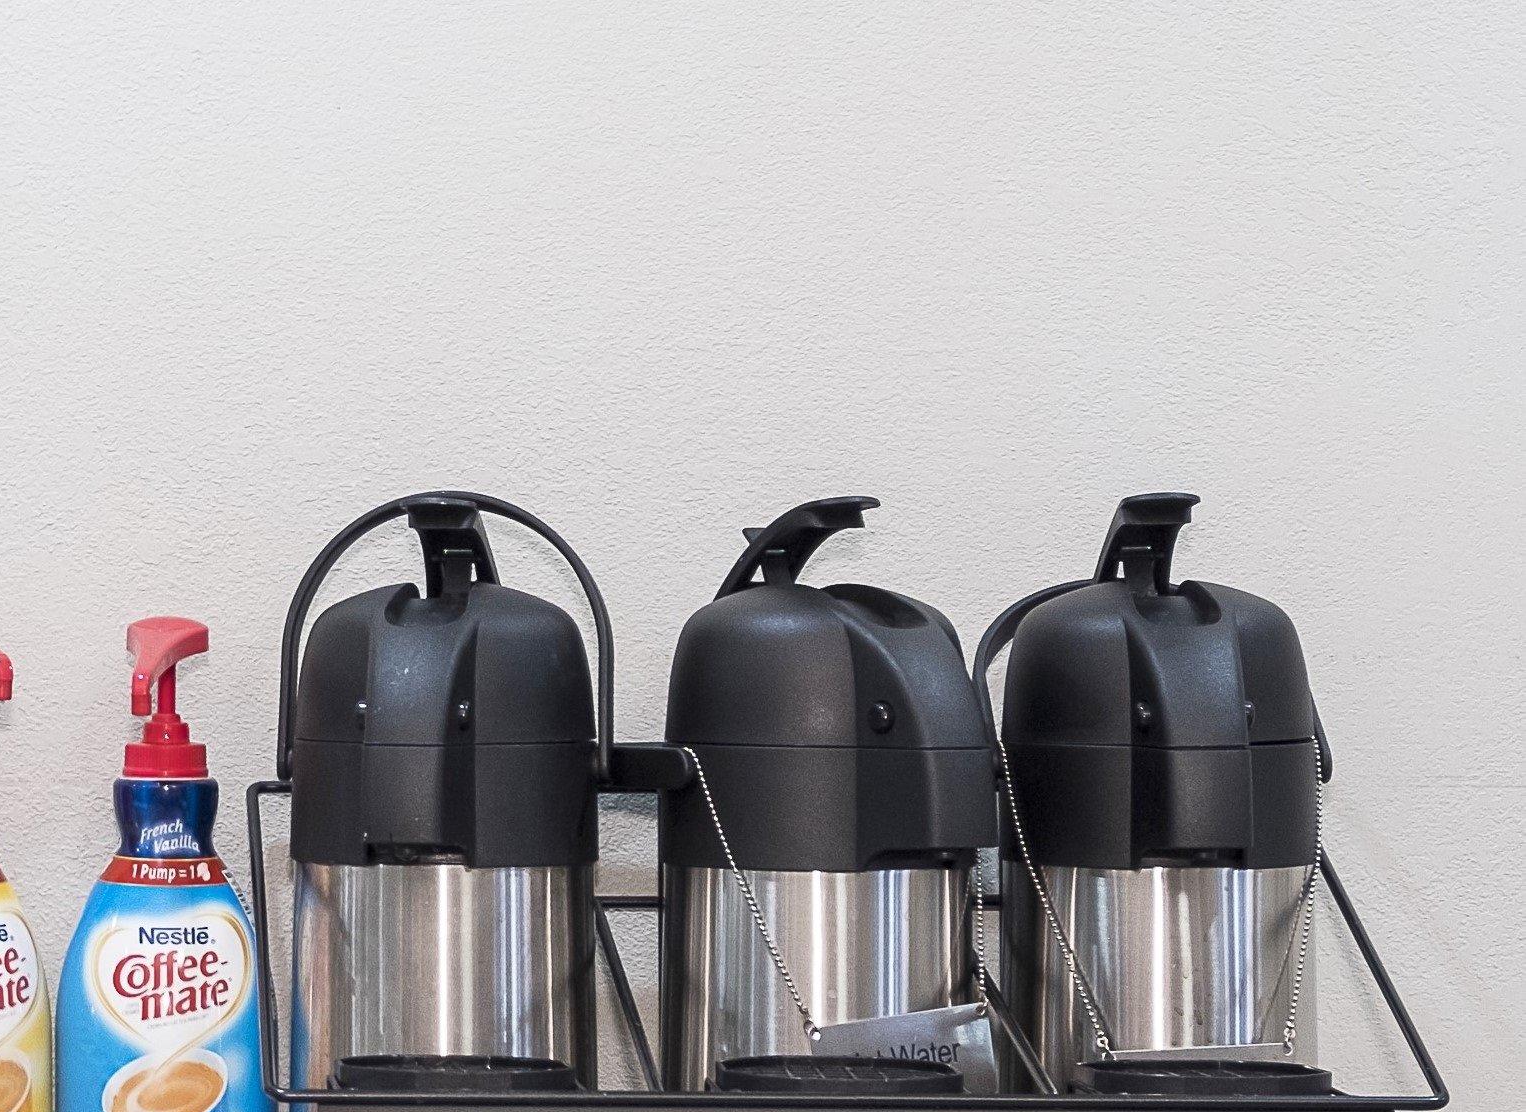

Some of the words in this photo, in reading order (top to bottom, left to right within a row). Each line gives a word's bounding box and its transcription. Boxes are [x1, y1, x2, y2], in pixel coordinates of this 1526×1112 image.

[139, 819, 184, 845] French
[153, 835, 200, 853] Vanilla
[132, 864, 137, 878] 1
[140, 864, 176, 883] Pump
[139, 926, 209, 945] Nestlé
[141, 978, 229, 1021] mate
[890, 1042, 961, 1063] Water
